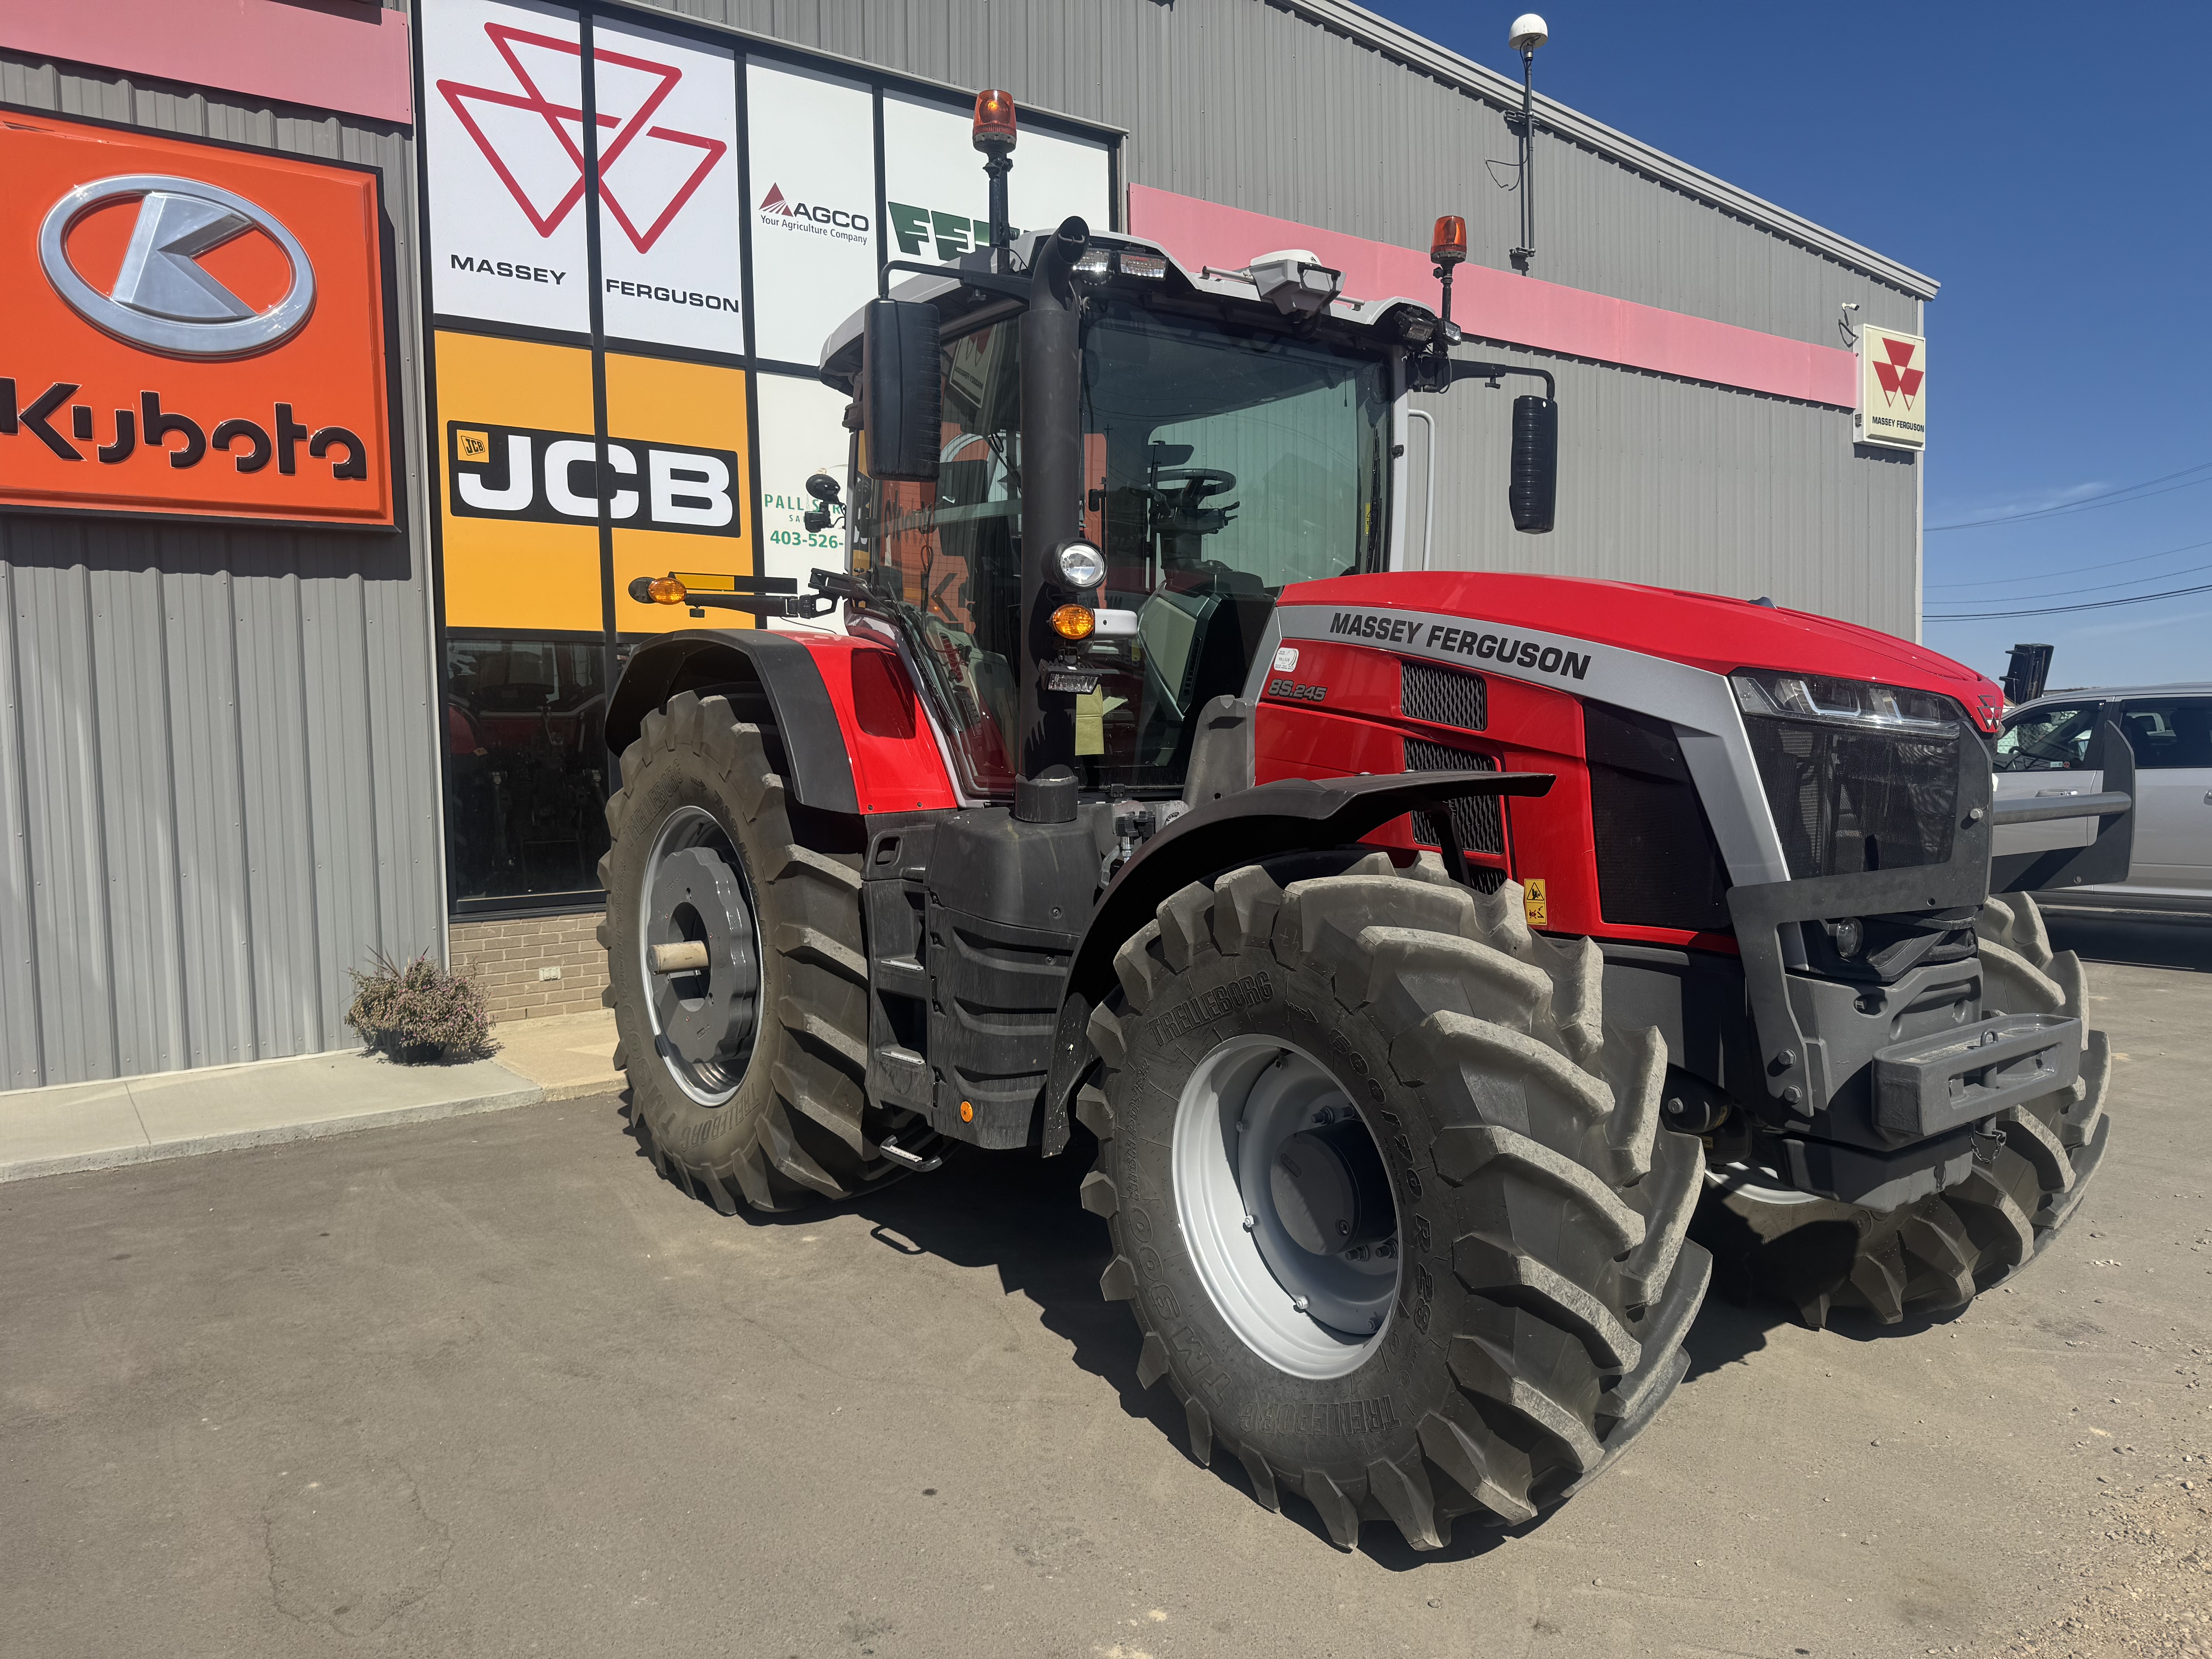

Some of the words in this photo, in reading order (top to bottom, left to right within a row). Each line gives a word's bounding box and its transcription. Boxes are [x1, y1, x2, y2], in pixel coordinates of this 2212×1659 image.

[761, 215, 780, 226] Your
[782, 219, 828, 235] Agriculture
[830, 229, 867, 246] Company
[794, 203, 869, 232] AGCO
[451, 254, 567, 285] MASSEY
[606, 278, 739, 313] FERGUSON
[0, 377, 368, 480] Kubota
[465, 438, 484, 453] JCB
[1872, 416, 1895, 427] MASSEY
[1896, 420, 1924, 433] FERGUSON
[458, 434, 734, 527] JCB
[770, 530, 844, 549] 403-526-
[1330, 613, 1424, 644] MASSEY
[1426, 625, 1592, 680] FERGUSON
[1268, 678, 1328, 702] 8S.245
[623, 758, 684, 848] TRELLEBORG
[1146, 970, 1274, 1046] TRELLEBORG
[680, 1083, 761, 1152] TRELLEBORG
[1239, 1395, 1402, 1437] TRELLEBORG
